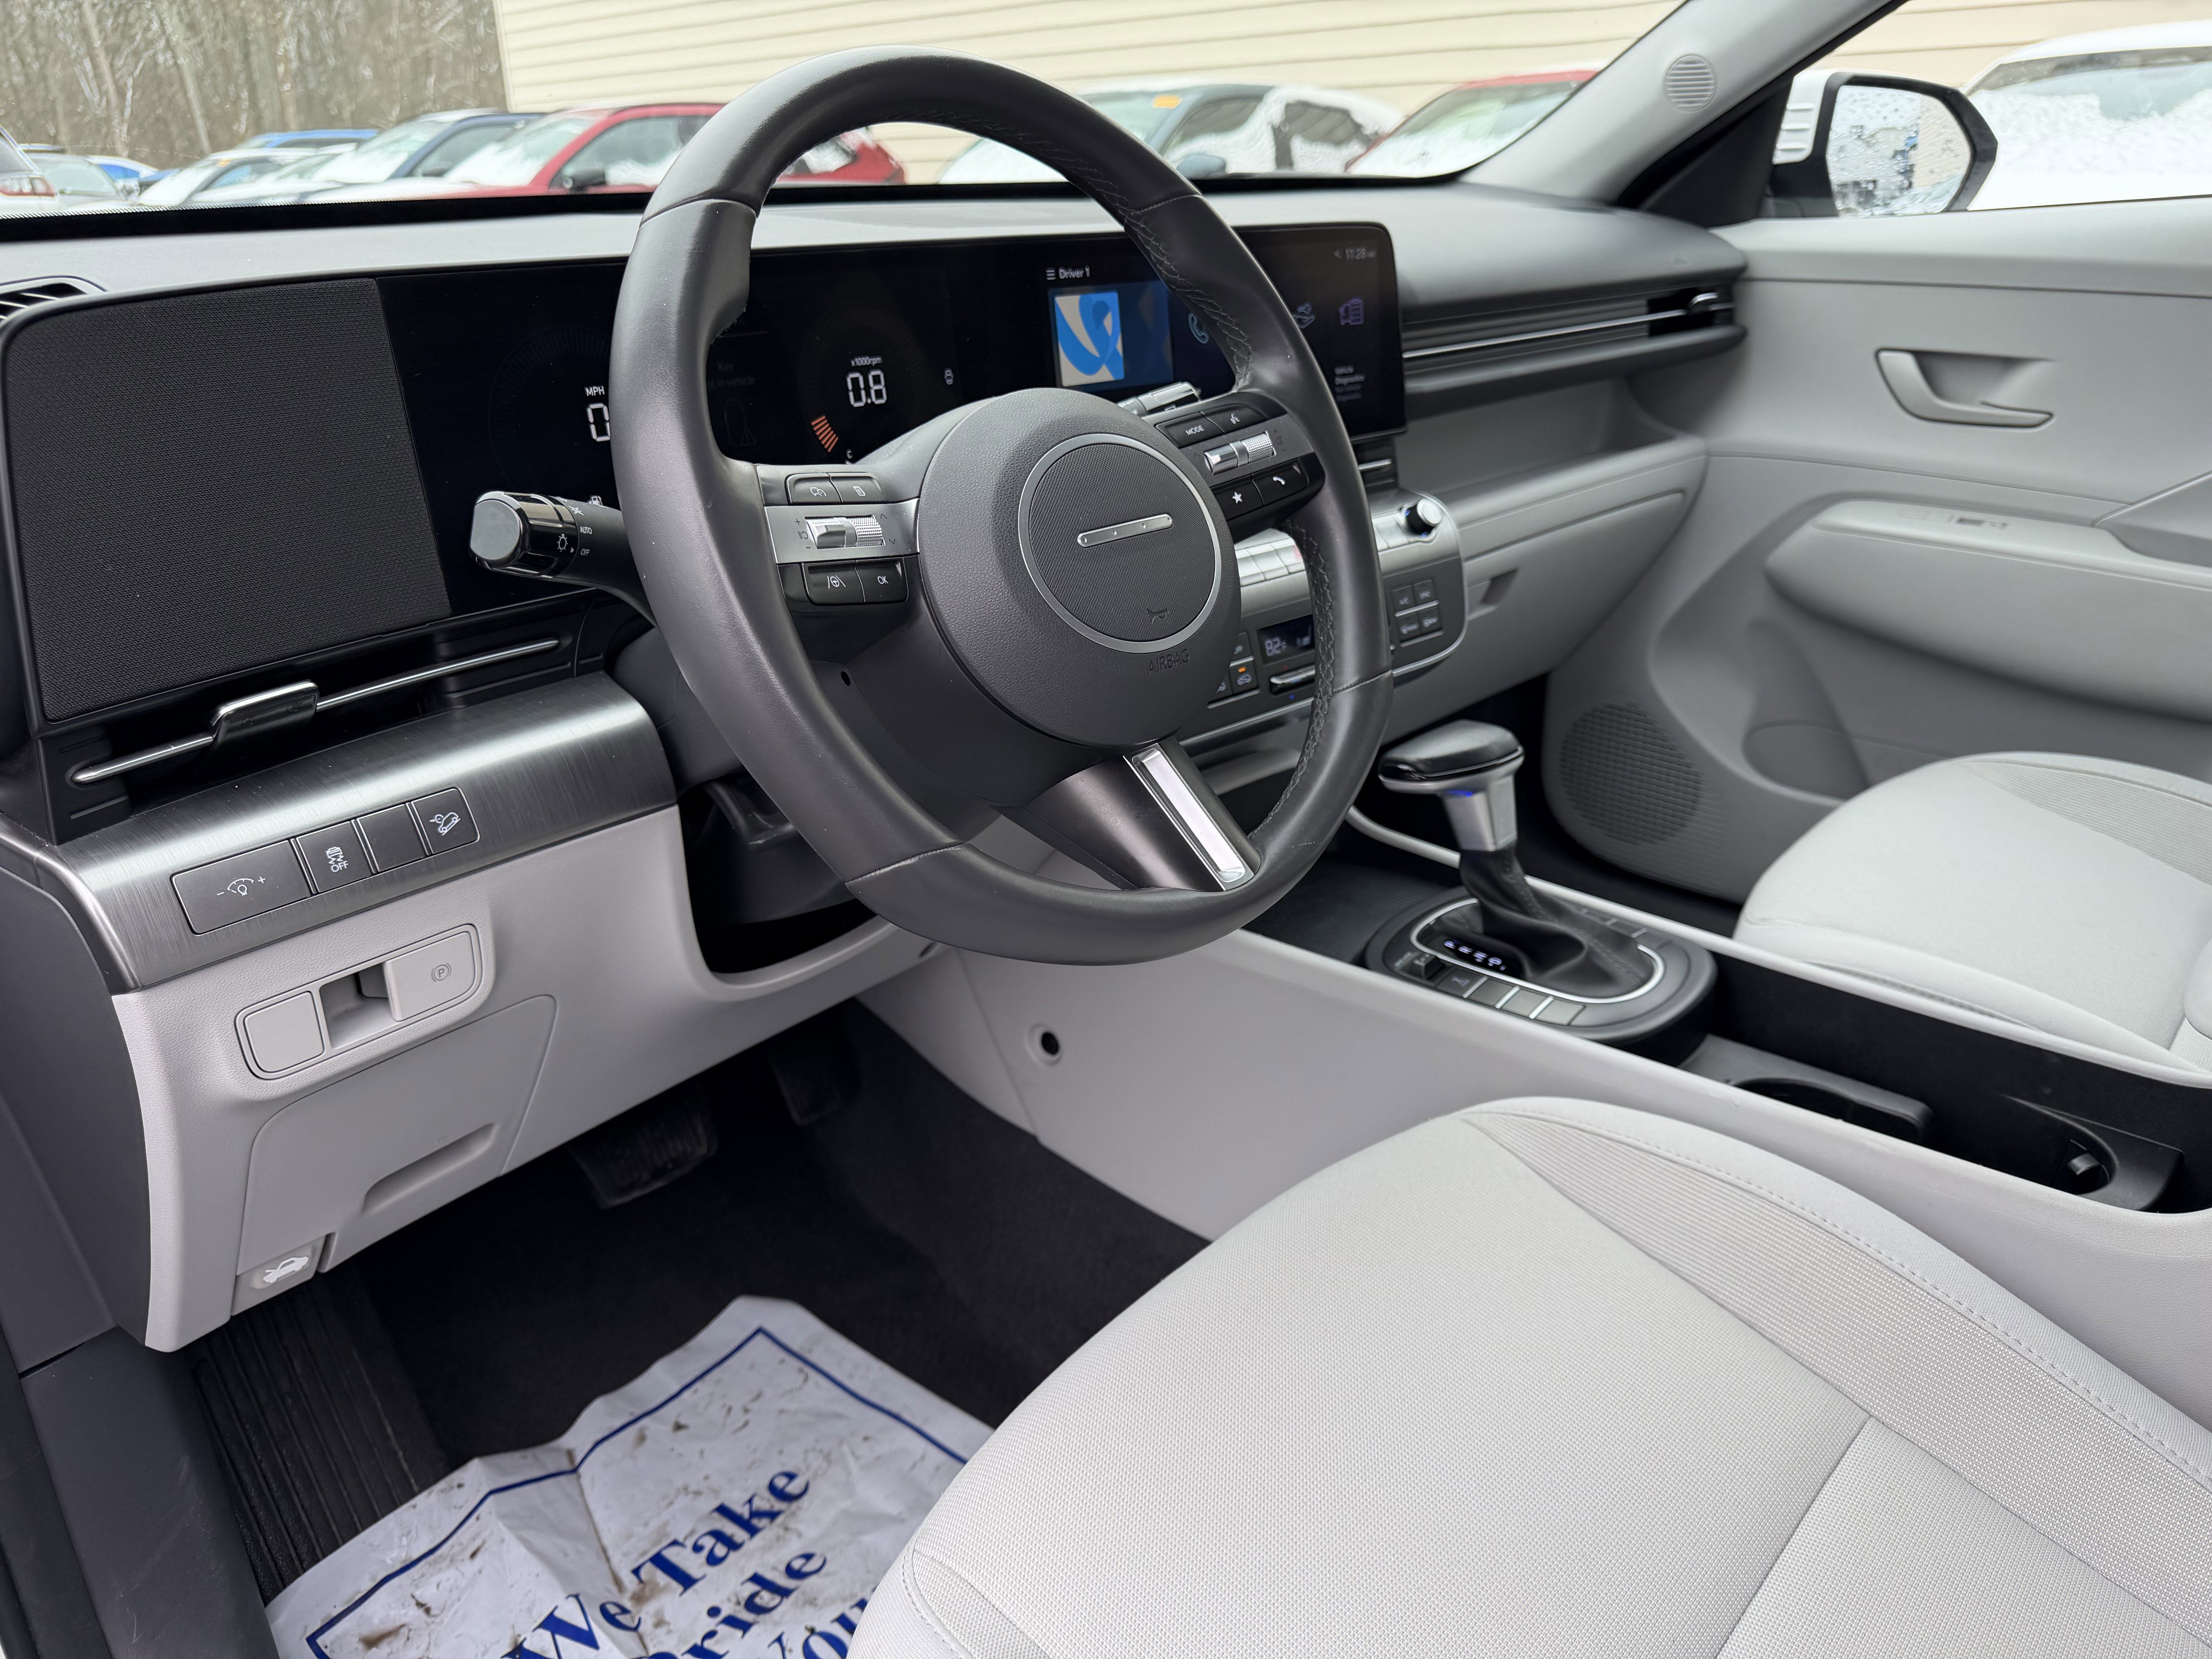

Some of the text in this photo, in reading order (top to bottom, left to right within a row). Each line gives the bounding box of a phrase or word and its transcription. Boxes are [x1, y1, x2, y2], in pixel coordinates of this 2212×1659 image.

[1058, 265, 1090, 279] Driver 1
[585, 385, 605, 397] MPH
[847, 370, 887, 407] 0.8
[586, 403, 610, 442] 0
[1185, 425, 1204, 436] MODE
[580, 526, 592, 534] AUTO
[878, 576, 888, 584] OK
[1149, 648, 1190, 676] AIRBAG
[331, 860, 349, 872] OFF
[501, 1471, 810, 1659] We Take
[630, 1552, 827, 1659] ride
